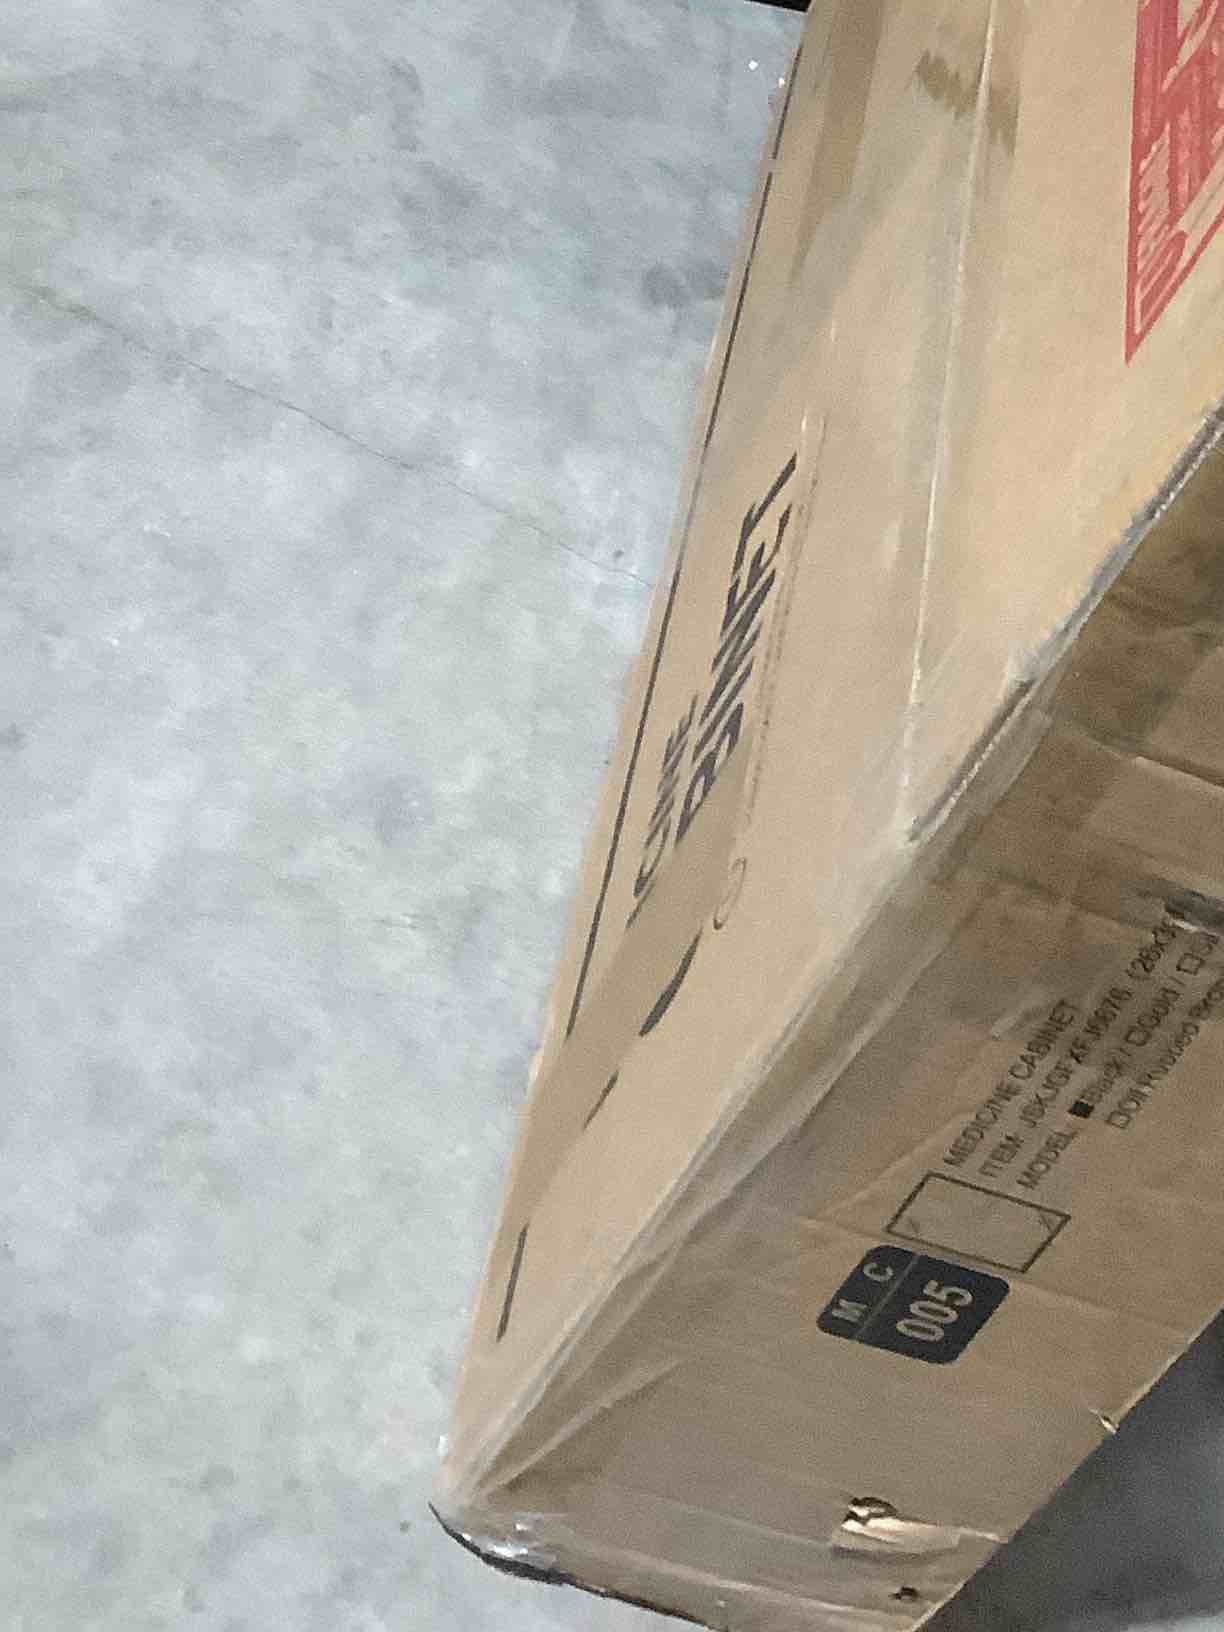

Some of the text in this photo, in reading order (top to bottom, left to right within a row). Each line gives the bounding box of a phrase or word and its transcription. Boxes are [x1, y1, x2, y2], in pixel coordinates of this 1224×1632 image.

[1008, 999, 1081, 1080] CABINET
[862, 1261, 894, 1282] C
[894, 1278, 975, 1343] 005
